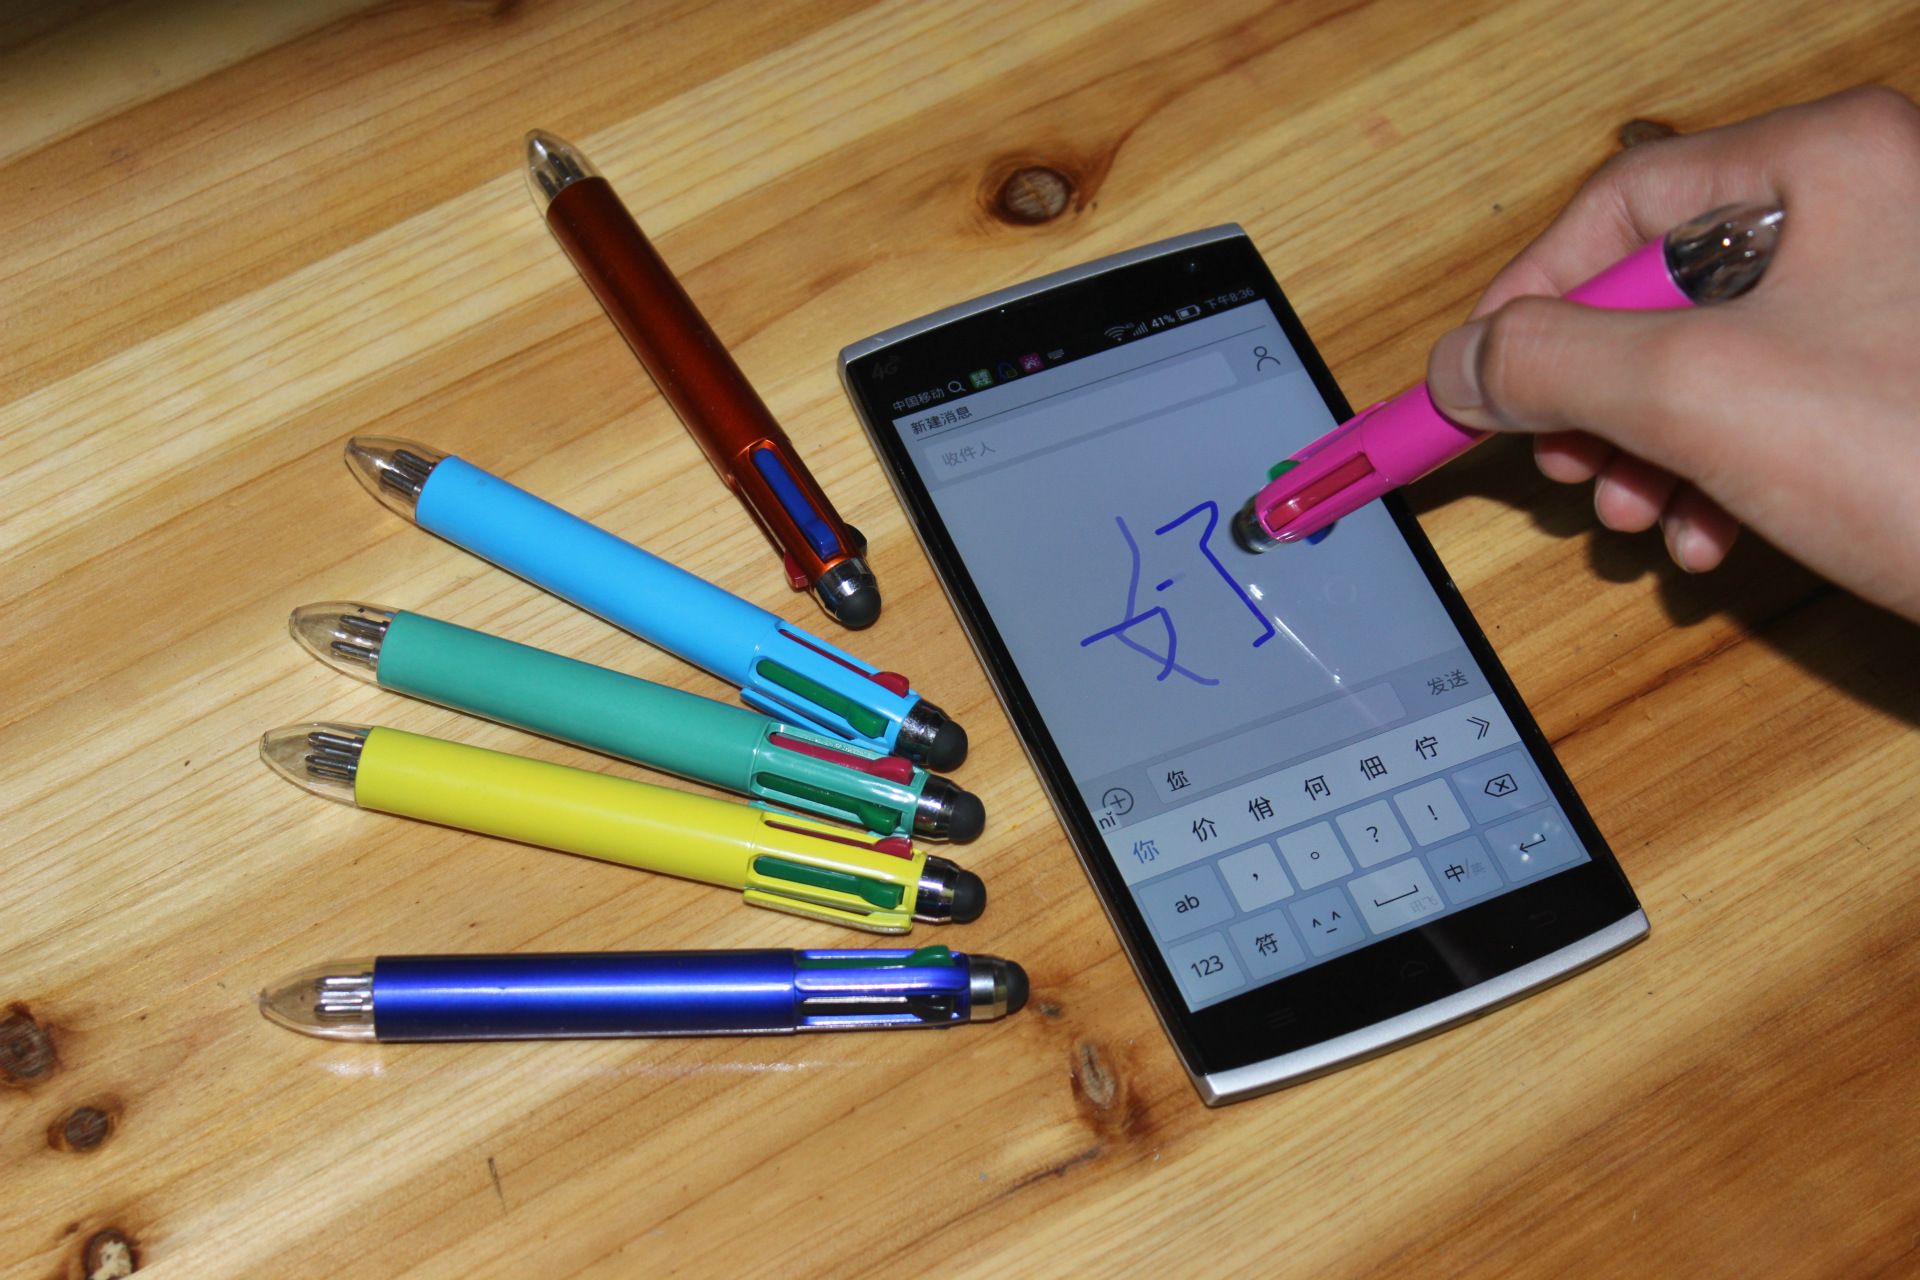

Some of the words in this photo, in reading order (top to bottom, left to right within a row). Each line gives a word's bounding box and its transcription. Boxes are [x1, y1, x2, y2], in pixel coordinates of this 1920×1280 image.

[1204, 287, 1255, 310] 下午8:36
[1151, 314, 1176, 329] 41%
[892, 387, 945, 412] 中国移动
[910, 405, 973, 436] 新建消息
[941, 440, 996, 467] 收件人
[1427, 669, 1469, 696] 发送
[1132, 840, 1160, 864] 你
[1192, 817, 1218, 843] 价
[1304, 775, 1331, 800] 何
[1360, 755, 1388, 781] 佃
[1175, 894, 1200, 914] ab
[1255, 933, 1279, 957] 符
[1190, 955, 1225, 978] 123
